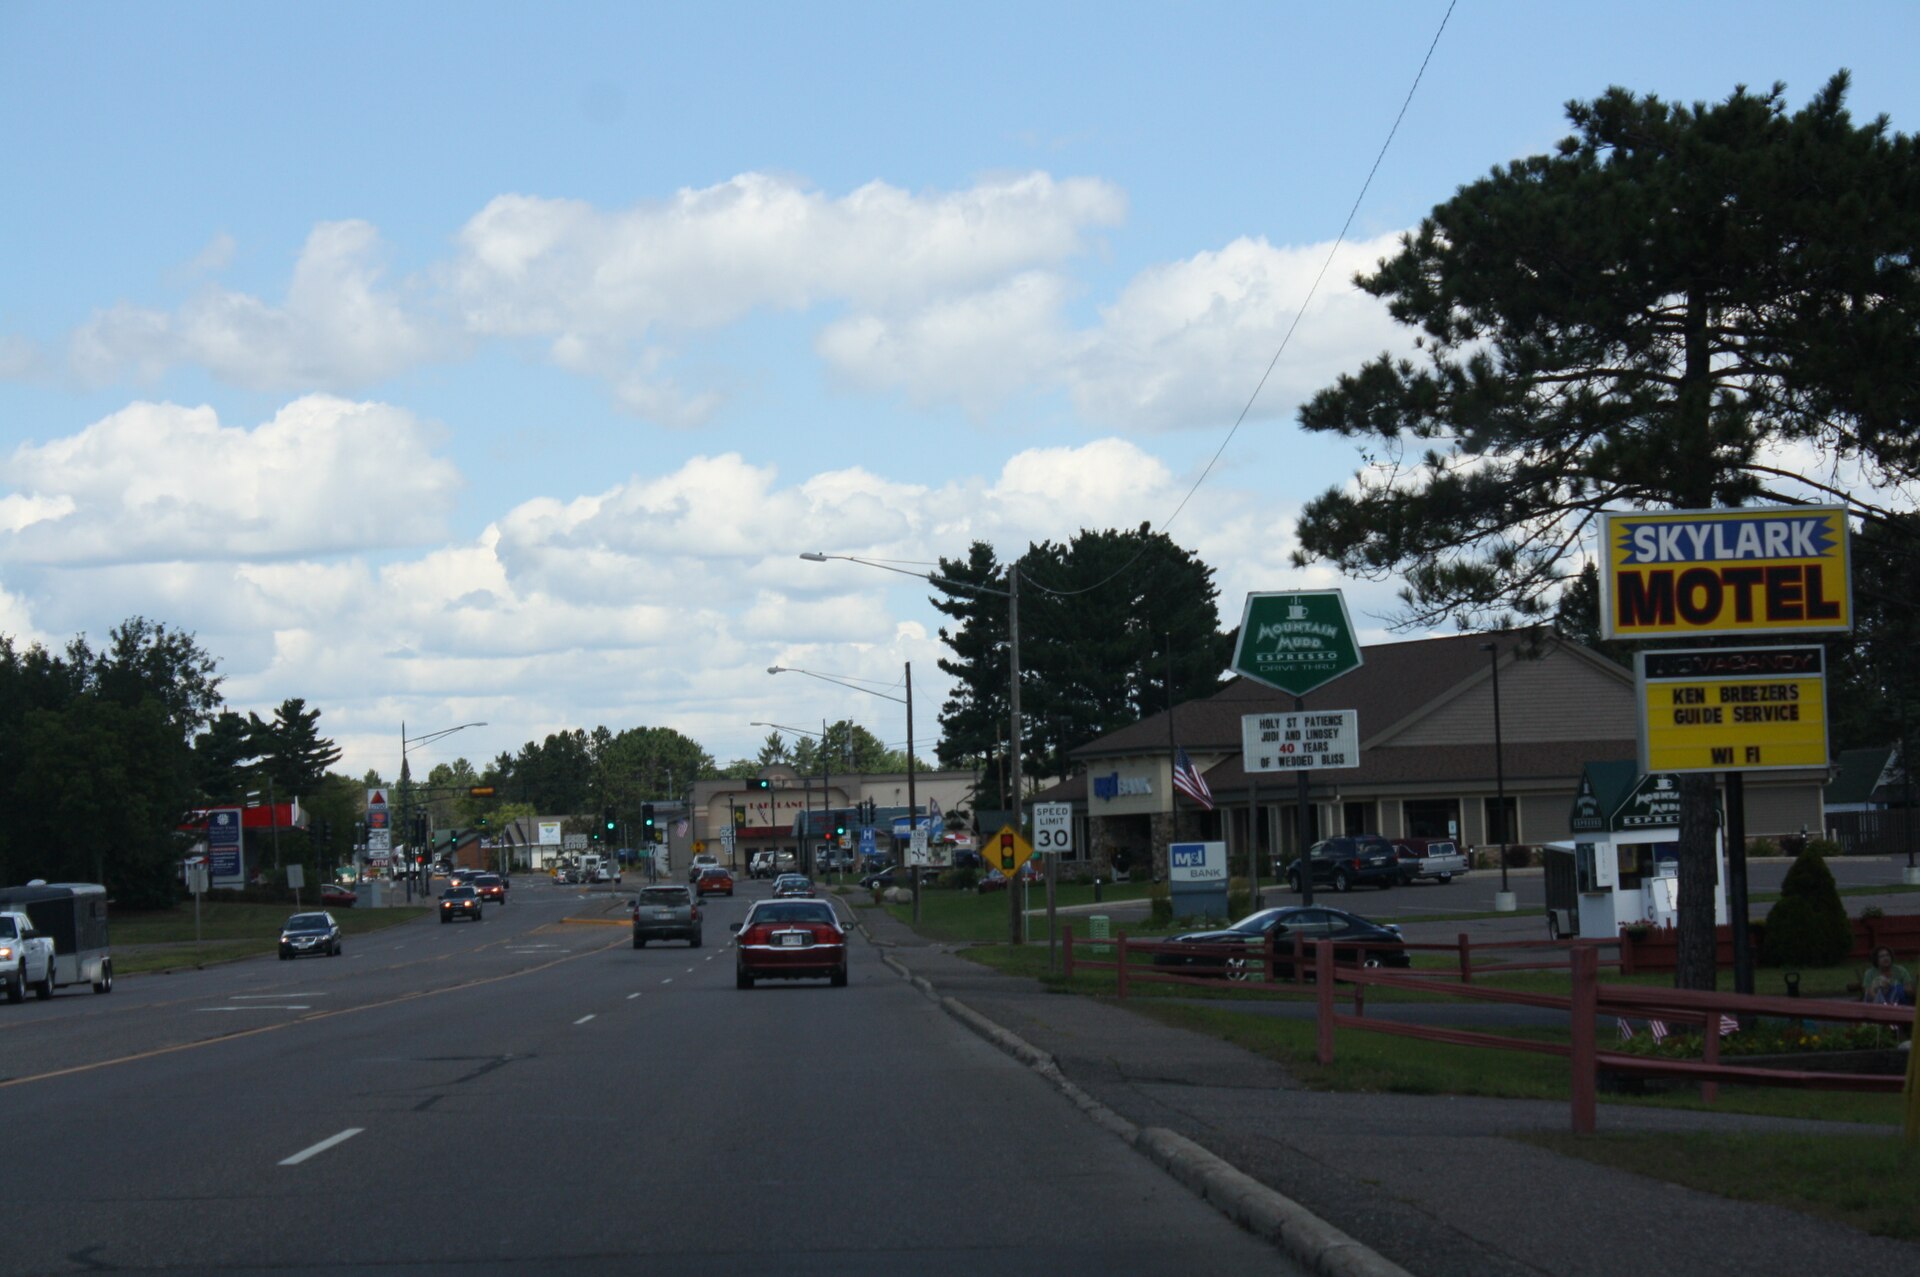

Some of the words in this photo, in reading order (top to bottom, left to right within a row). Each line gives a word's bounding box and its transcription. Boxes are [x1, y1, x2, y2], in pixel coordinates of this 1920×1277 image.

[1634, 520, 1818, 563] SKYLARK
[1617, 564, 1840, 627] MOTEL
[1256, 622, 1339, 644] MOUNTAIN
[1275, 637, 1324, 653] MUDD
[1256, 653, 1338, 661] ESPRESSO
[1693, 654, 1814, 671] VACANCY
[1259, 664, 1297, 672] DRIVE
[1302, 663, 1337, 671] THRU
[1672, 687, 1705, 705] KEN
[1720, 684, 1800, 703] BREEZERS
[1673, 706, 1723, 725] GUIDE
[1733, 704, 1800, 723] SERVICE
[1259, 718, 1280, 730] HOLY
[1287, 717, 1297, 728] ST
[1304, 715, 1344, 728] PATIENCE
[1261, 731, 1279, 742] JUDI
[1285, 730, 1301, 741] AND
[1306, 728, 1339, 740] LINDSEY
[1279, 743, 1295, 754] 40
[1302, 742, 1329, 753] YEARS
[1711, 747, 1733, 765] WI
[1746, 746, 1761, 764] FI
[1261, 757, 1271, 768] OF
[1278, 756, 1314, 768] WEDDED
[1322, 754, 1345, 766] BLISS
[1119, 777, 1152, 795] BANK
[1036, 807, 1068, 816] SPEED
[1040, 817, 1064, 826] LIMIT
[863, 829, 872, 840] H
[1038, 829, 1068, 847] 30
[372, 859, 389, 867] ATM
[1175, 849, 1203, 866] M&I
[1190, 869, 1221, 878] BANK
